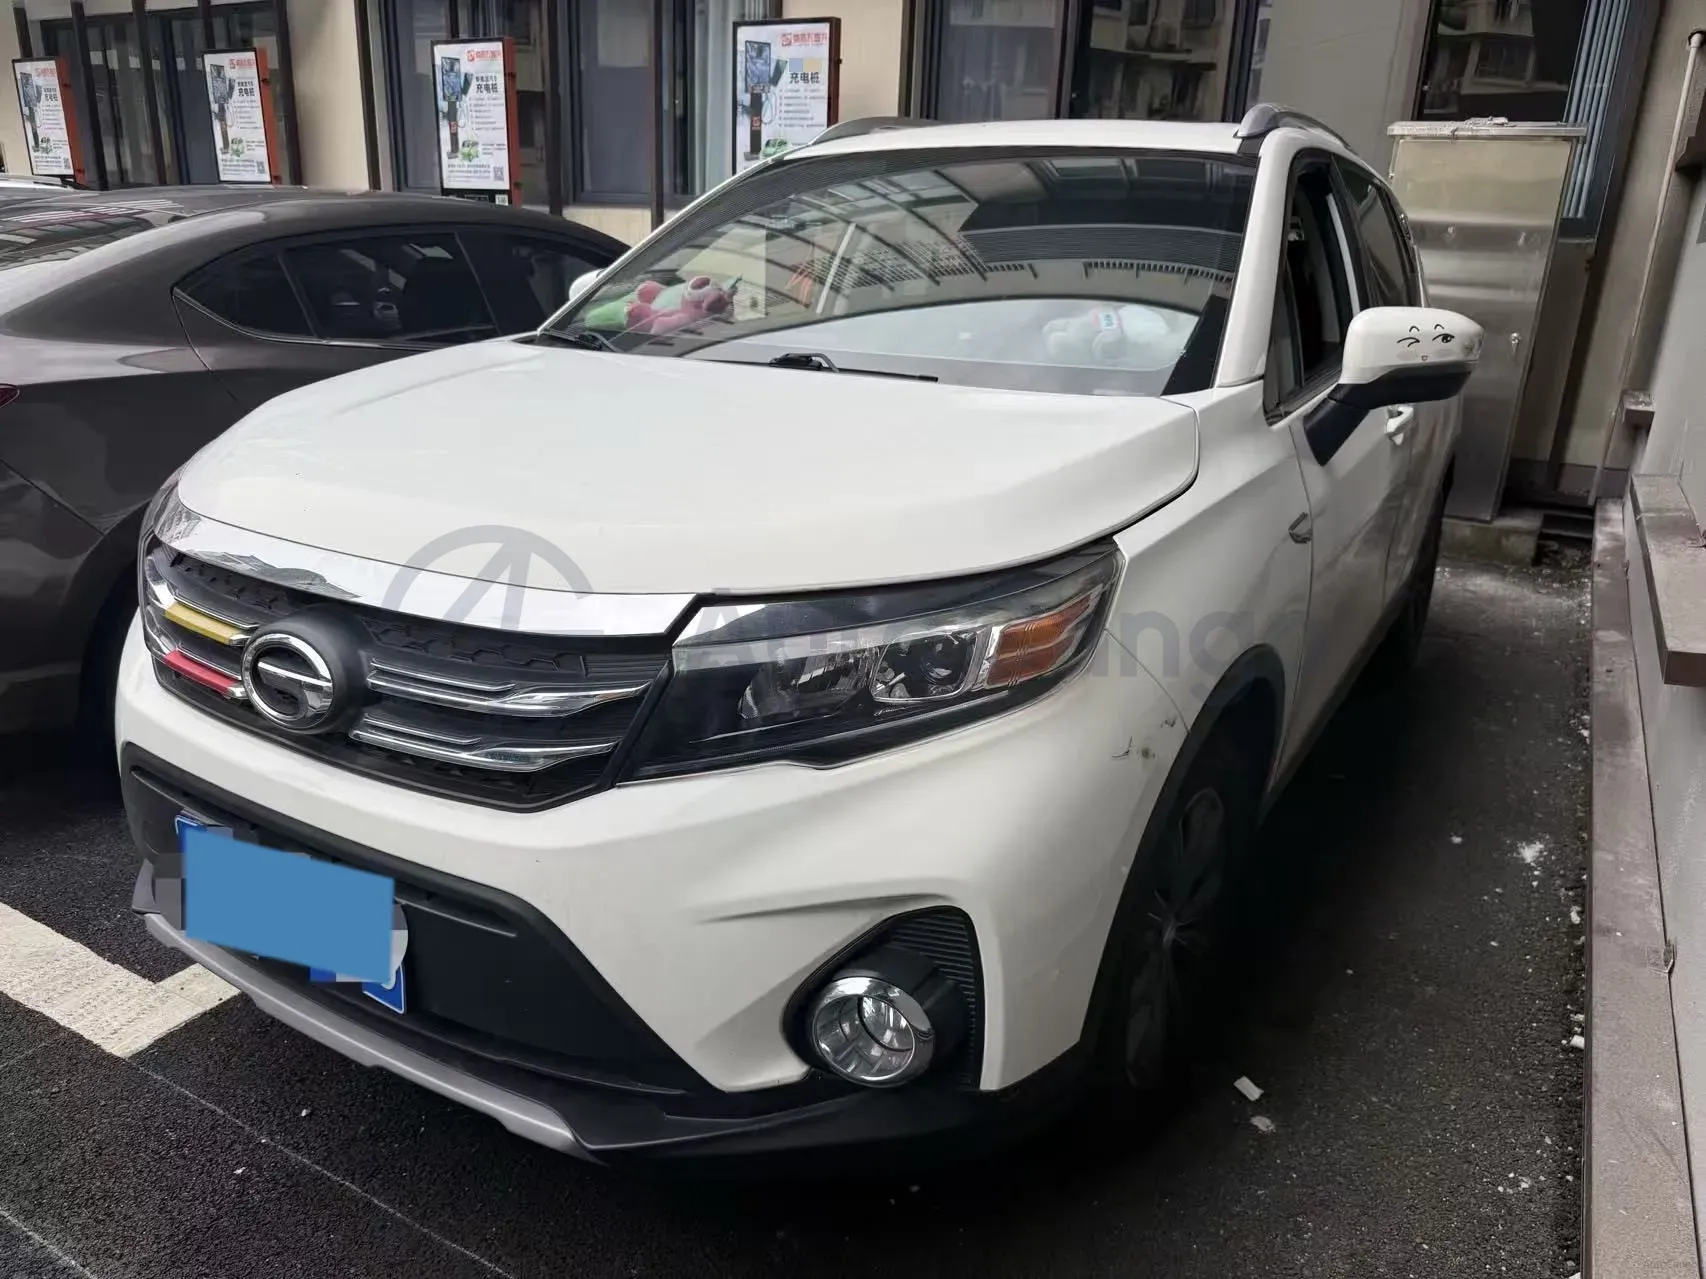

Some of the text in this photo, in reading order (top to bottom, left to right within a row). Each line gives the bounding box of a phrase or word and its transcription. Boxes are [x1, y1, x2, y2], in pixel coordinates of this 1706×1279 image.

[788, 71, 820, 84] 充电桩
[475, 83, 499, 94] 充电桩
